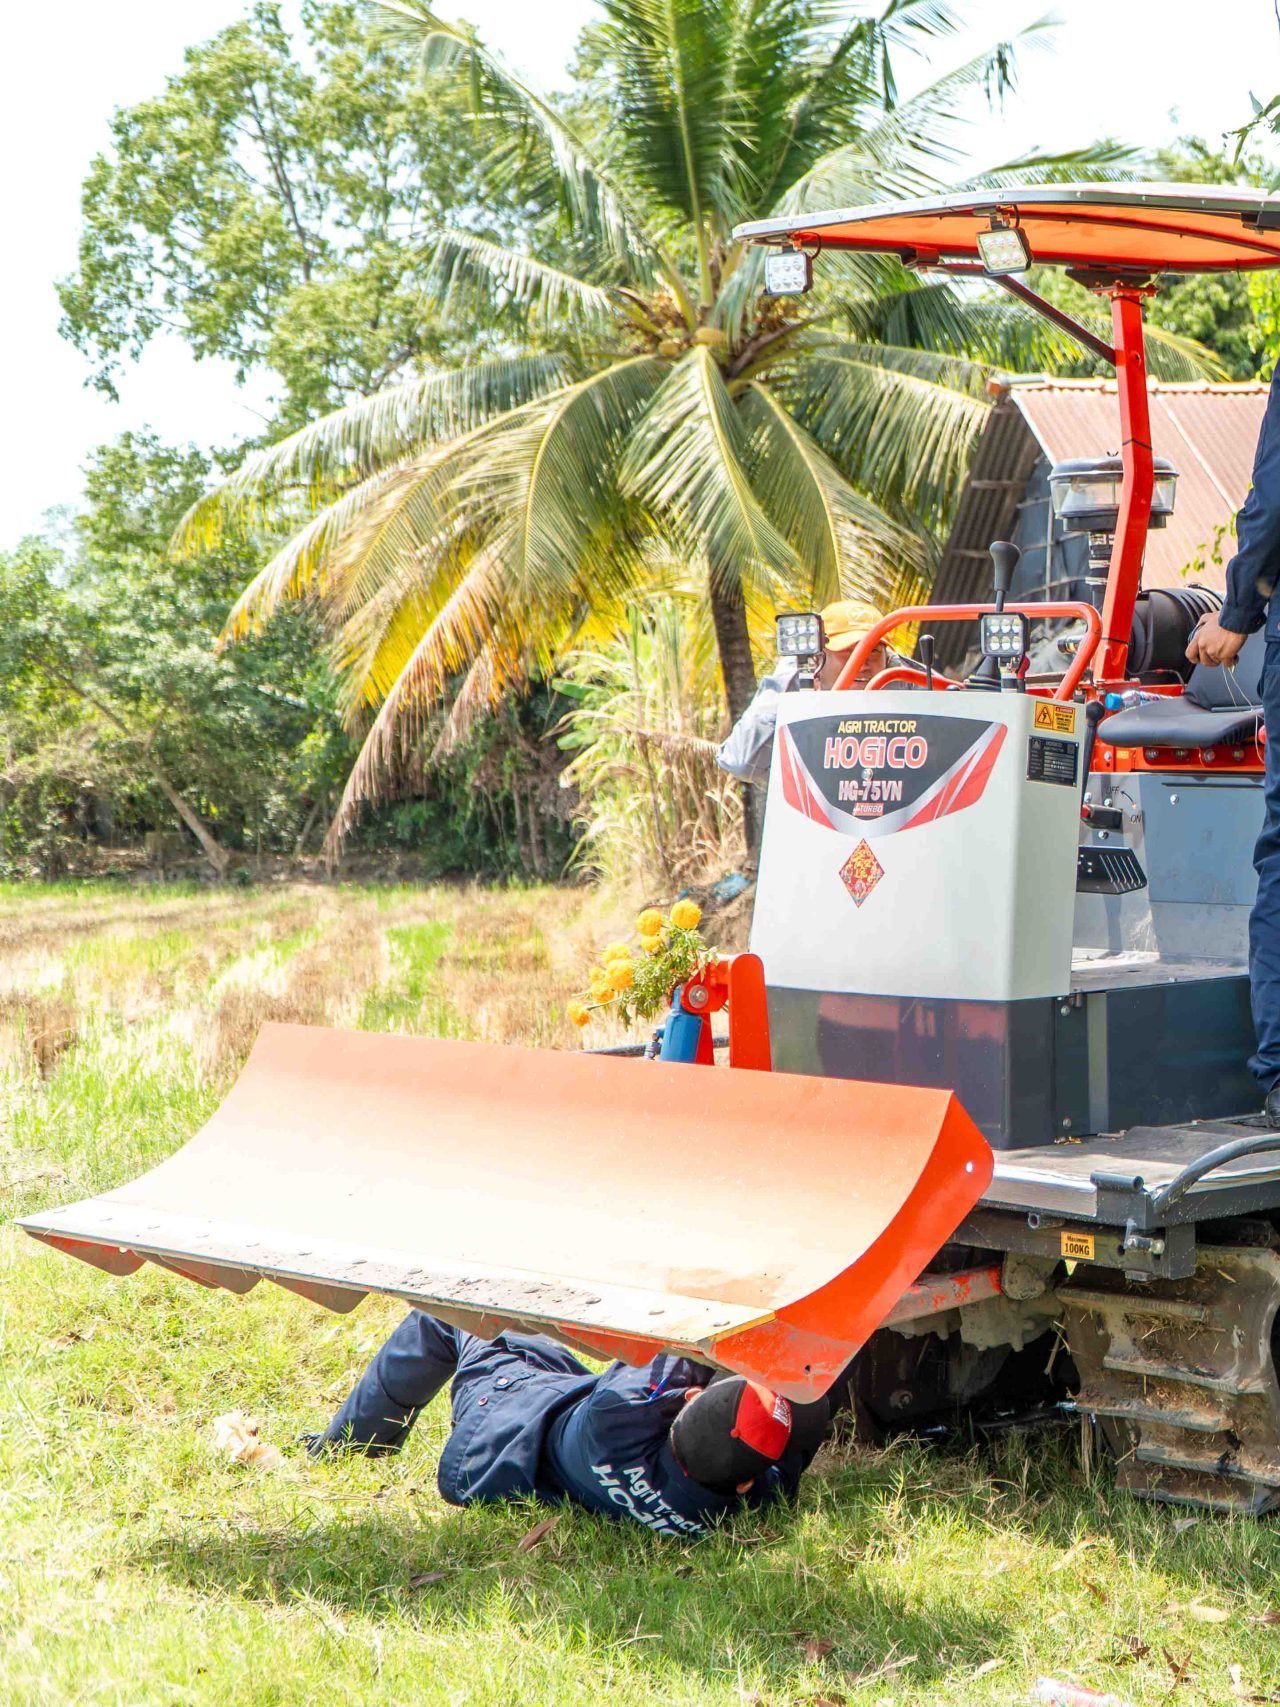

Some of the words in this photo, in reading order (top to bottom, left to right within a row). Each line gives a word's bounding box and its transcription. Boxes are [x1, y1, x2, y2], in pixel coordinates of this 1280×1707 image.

[837, 720, 863, 734] AGRI
[863, 719, 918, 734] TRACTOR
[838, 779, 903, 801] HG-75VN
[1065, 1243, 1090, 1255] 100KG
[622, 1465, 662, 1505] Agri
